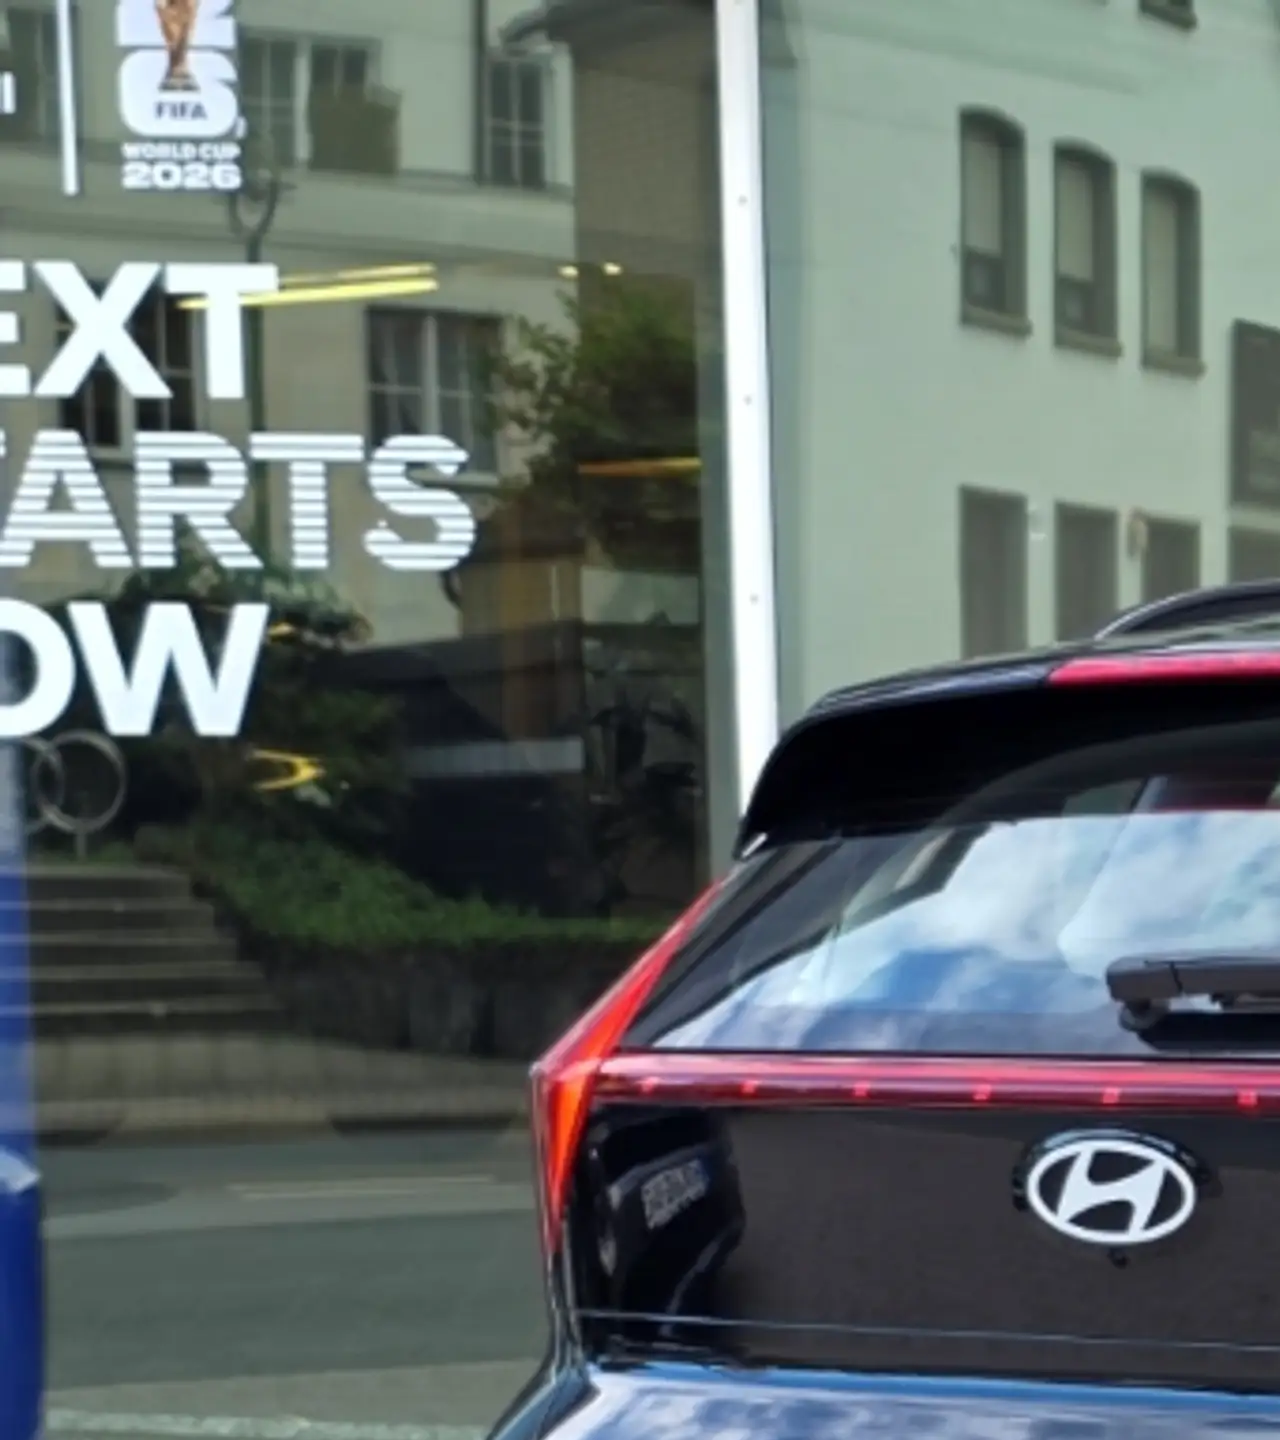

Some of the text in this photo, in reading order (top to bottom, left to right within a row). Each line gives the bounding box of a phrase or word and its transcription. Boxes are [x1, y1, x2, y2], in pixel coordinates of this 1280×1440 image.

[155, 101, 208, 119] FIFA
[121, 142, 242, 161] WORLD CUP
[121, 161, 242, 190] 2026
[0, 429, 476, 571] ARTS
